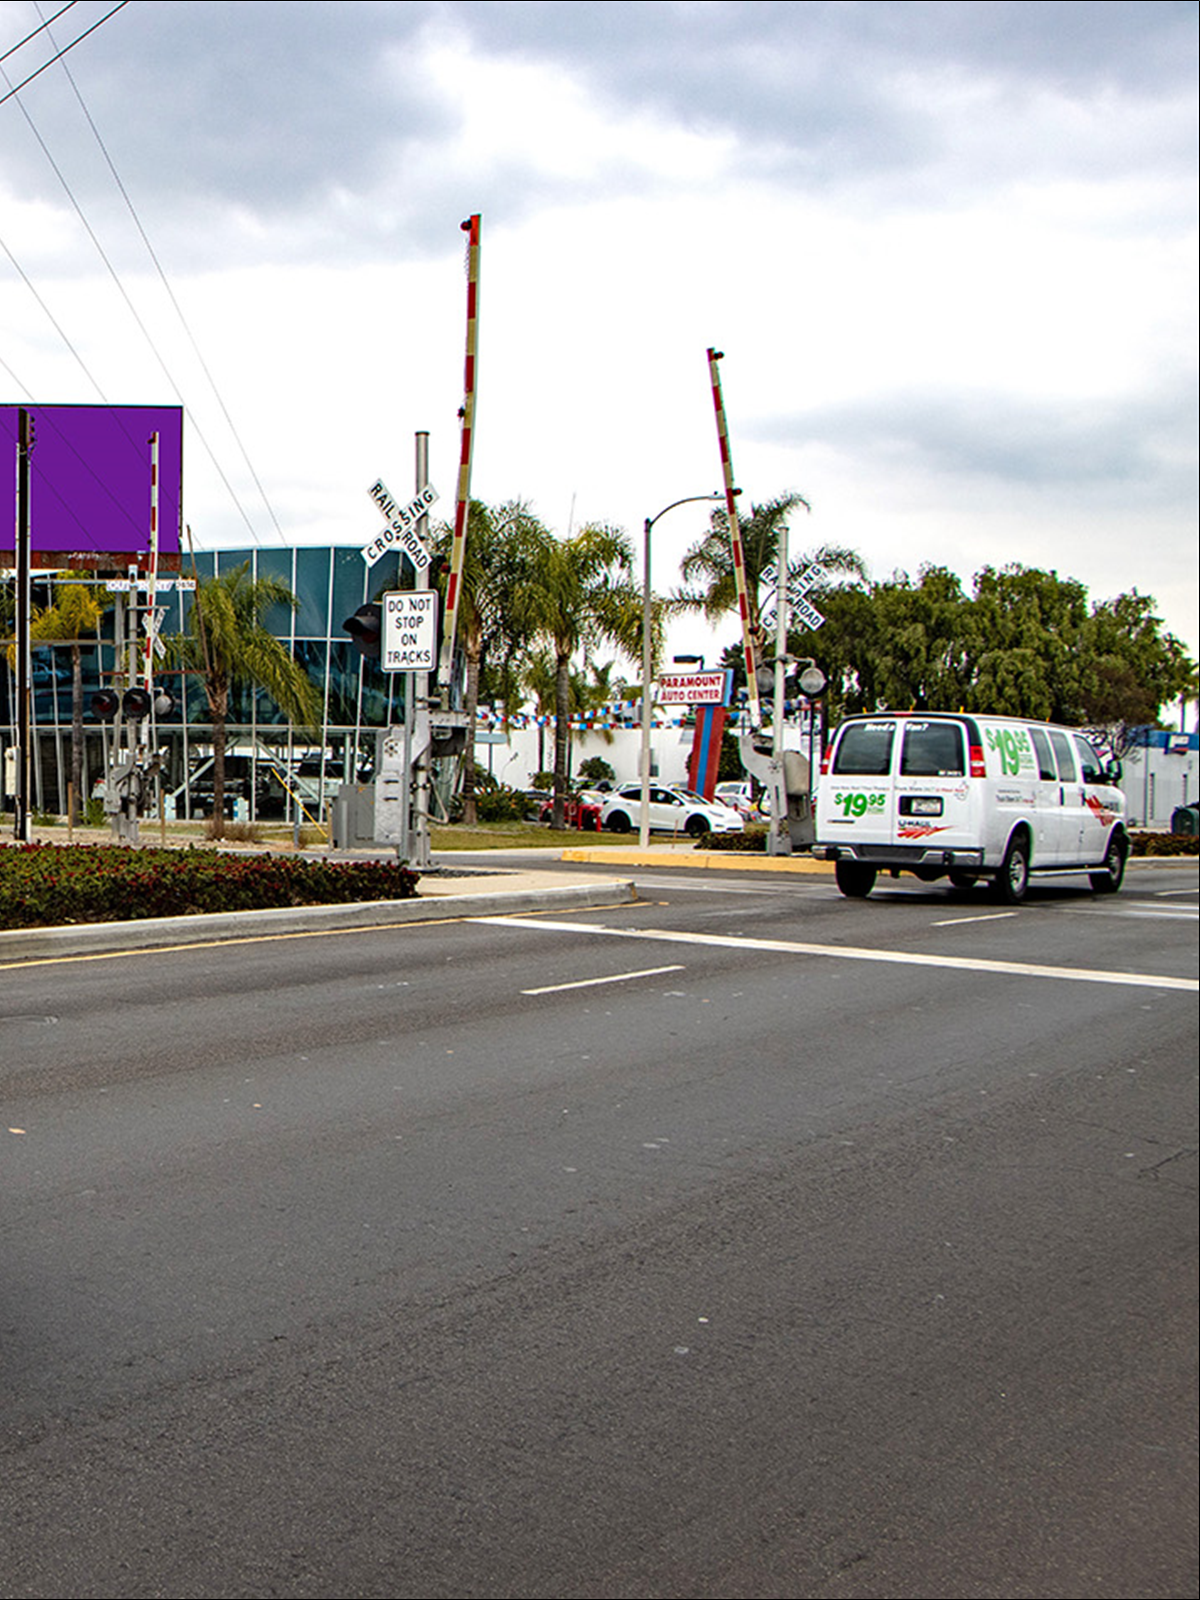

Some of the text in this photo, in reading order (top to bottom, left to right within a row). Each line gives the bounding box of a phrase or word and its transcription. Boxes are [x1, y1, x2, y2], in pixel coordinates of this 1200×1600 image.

[367, 489, 434, 560] CROSSING
[371, 483, 429, 569] RAIL ROAD
[388, 598, 431, 613] DO NOT
[794, 598, 821, 627] ROAD
[395, 615, 424, 629] STOP
[401, 633, 418, 647] ON
[387, 649, 431, 664] TRACKS
[660, 676, 721, 688] PARAMOUNT
[661, 688, 720, 701] AUTO CENTER
